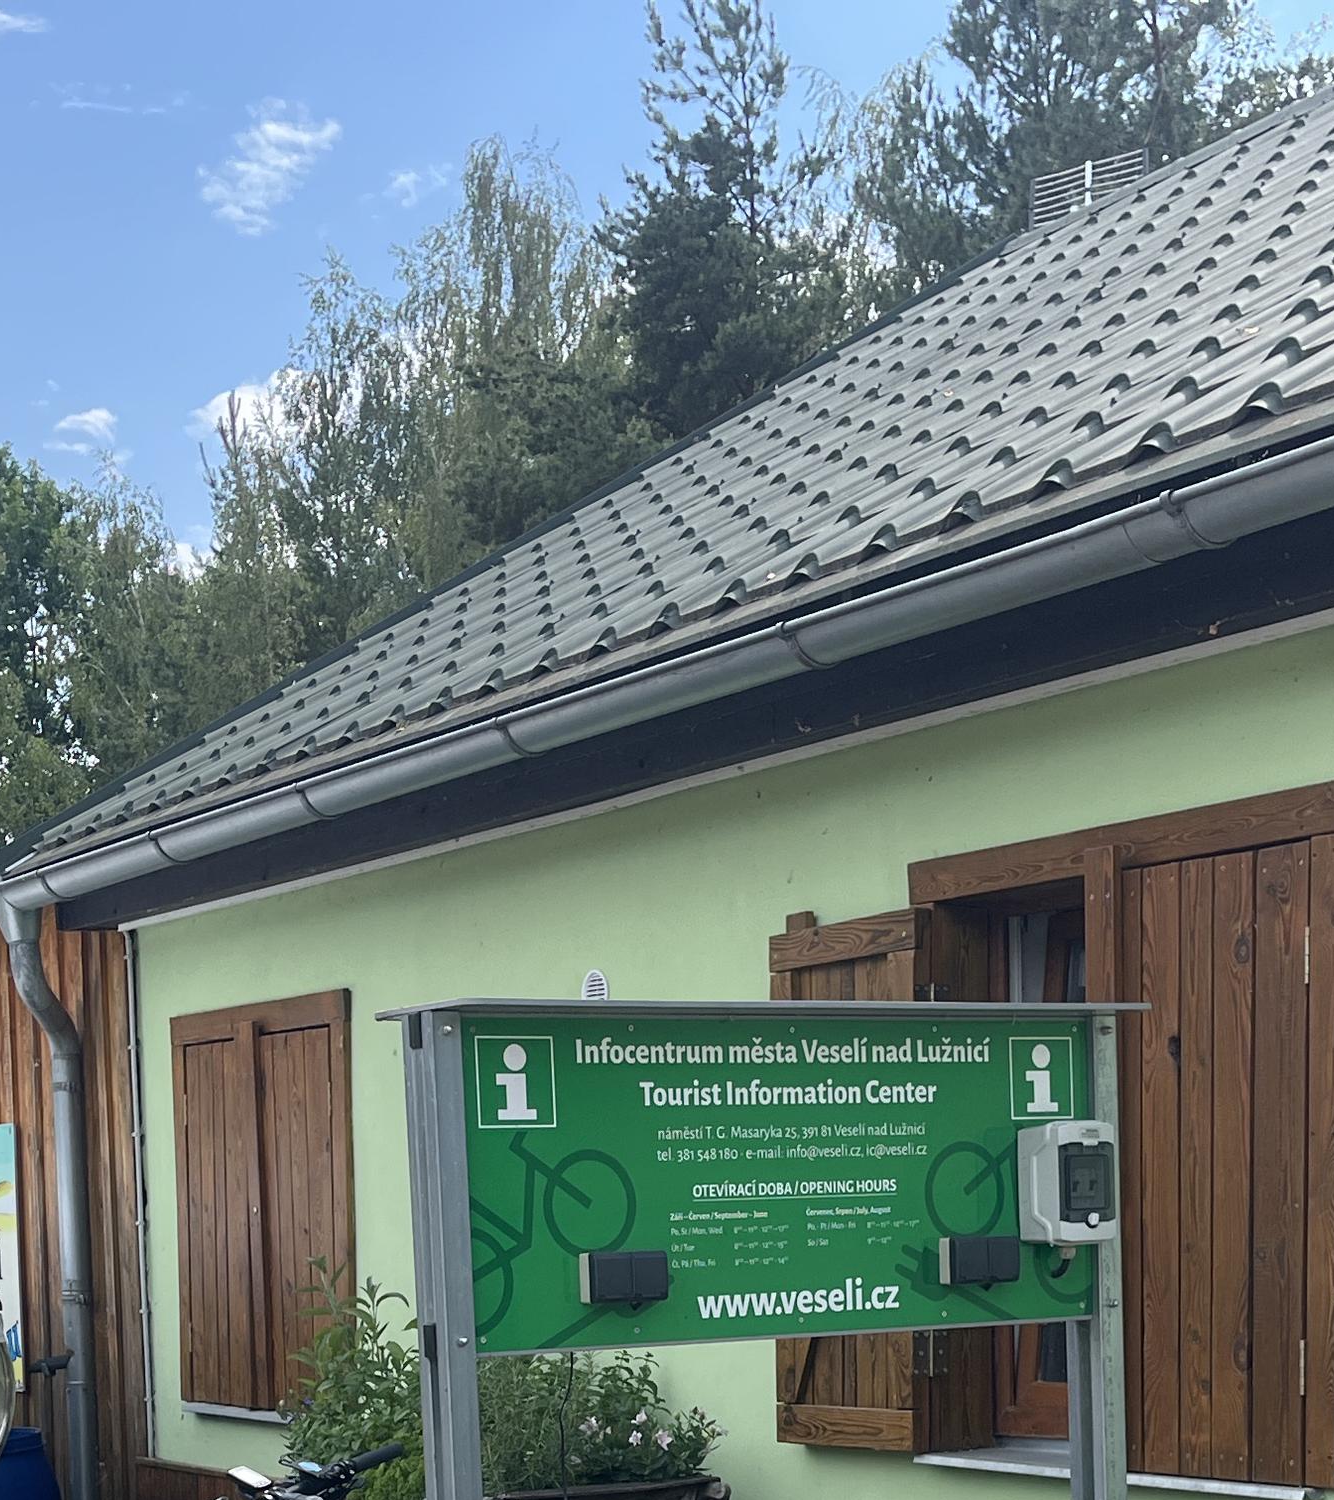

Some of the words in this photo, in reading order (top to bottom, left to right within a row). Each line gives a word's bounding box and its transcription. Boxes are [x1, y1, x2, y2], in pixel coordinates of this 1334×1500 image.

[575, 1037, 723, 1064] Infocentrum
[728, 1037, 798, 1064] města
[801, 1037, 868, 1063] Veselí
[872, 1037, 913, 1063] nad
[917, 1037, 990, 1062] Lužnicí
[639, 1079, 722, 1106] Tourist
[726, 1079, 861, 1105] Information
[865, 1080, 937, 1104] Center
[657, 1126, 704, 1140] náměstí
[731, 1125, 783, 1141] Masaryka
[802, 1126, 819, 1139] 391
[820, 1125, 832, 1137] 81
[834, 1123, 866, 1137] Veselí
[867, 1122, 888, 1136] nad
[889, 1122, 926, 1136] Lužnicí
[677, 1148, 694, 1162] 381
[697, 1148, 717, 1161] 548
[718, 1148, 738, 1160] 180
[692, 1180, 757, 1198] OTEVÍRACÍ
[758, 1182, 793, 1196] DOBA
[799, 1180, 855, 1195] OPENING
[856, 1179, 898, 1193] HOURS
[697, 1277, 900, 1319] www.veseli.cz
